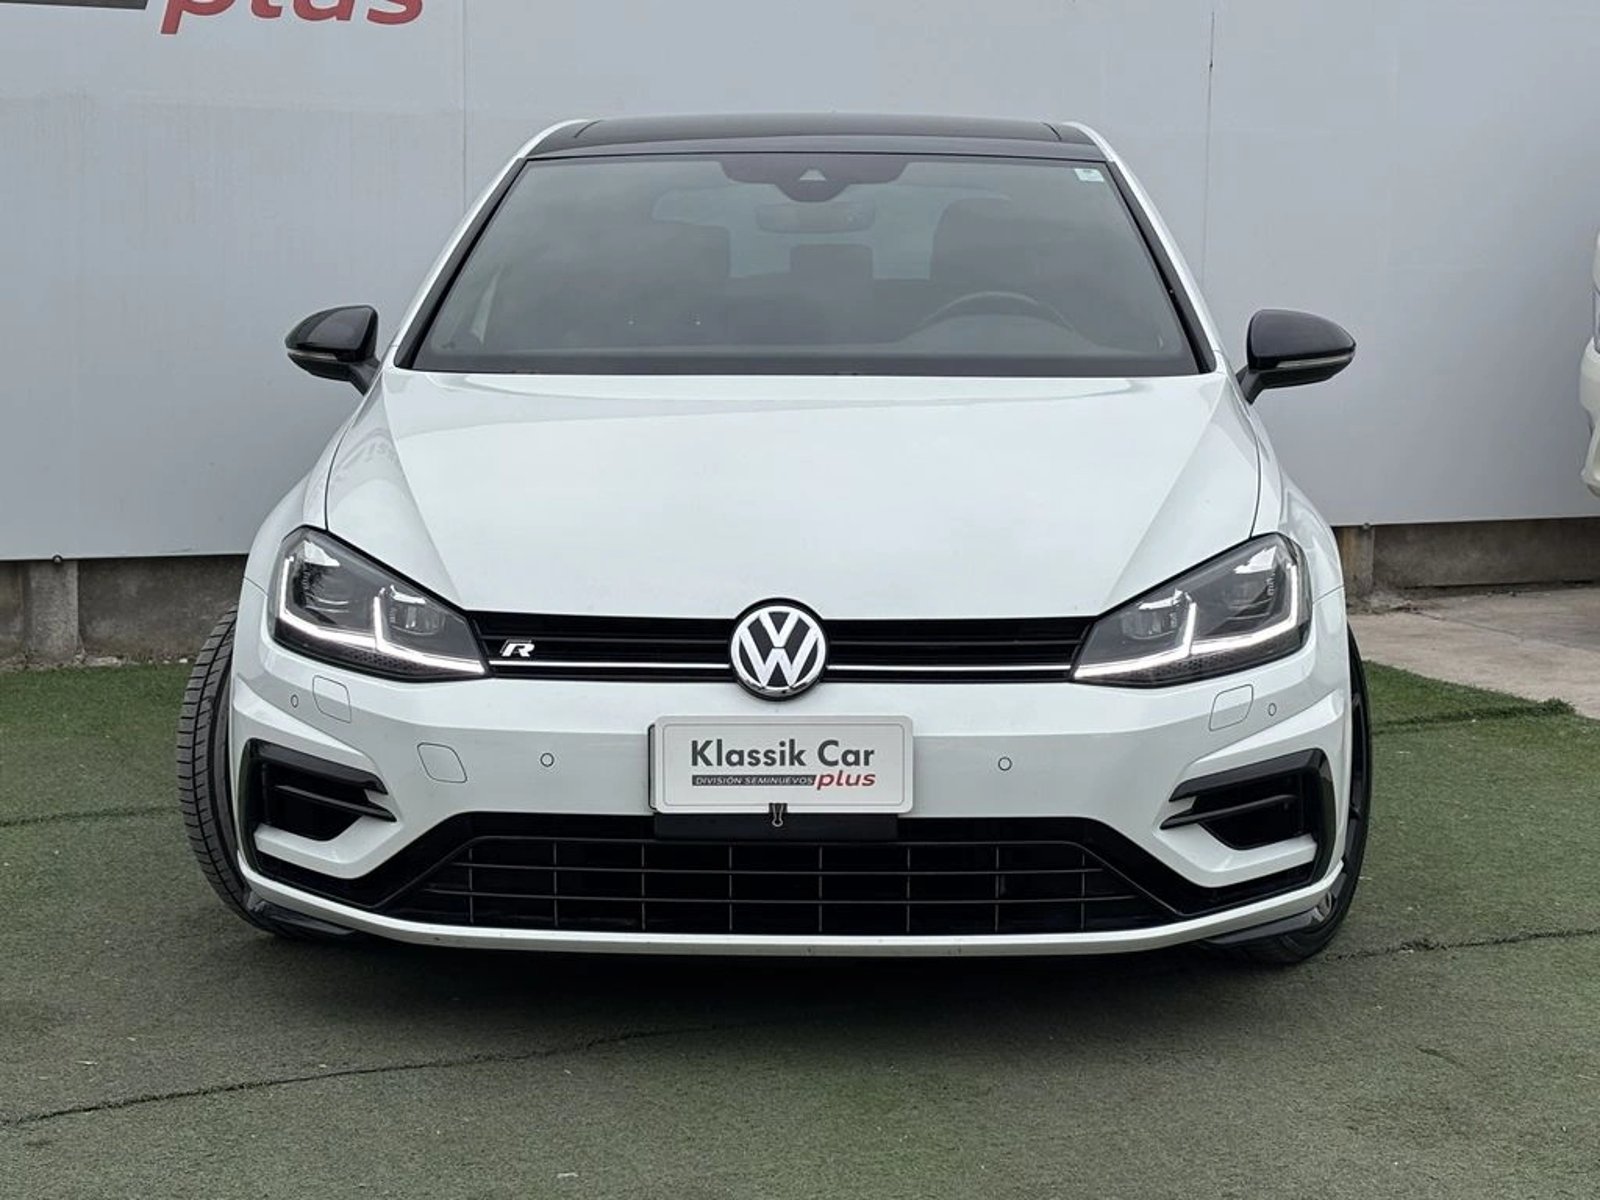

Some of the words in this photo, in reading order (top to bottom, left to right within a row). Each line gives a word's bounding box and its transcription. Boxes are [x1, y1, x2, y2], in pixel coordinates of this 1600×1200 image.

[501, 640, 535, 657] R
[691, 739, 807, 767] Klassik
[817, 739, 875, 767] Car
[745, 776, 814, 785] SEMINUEVOS
[816, 770, 876, 790] plus
